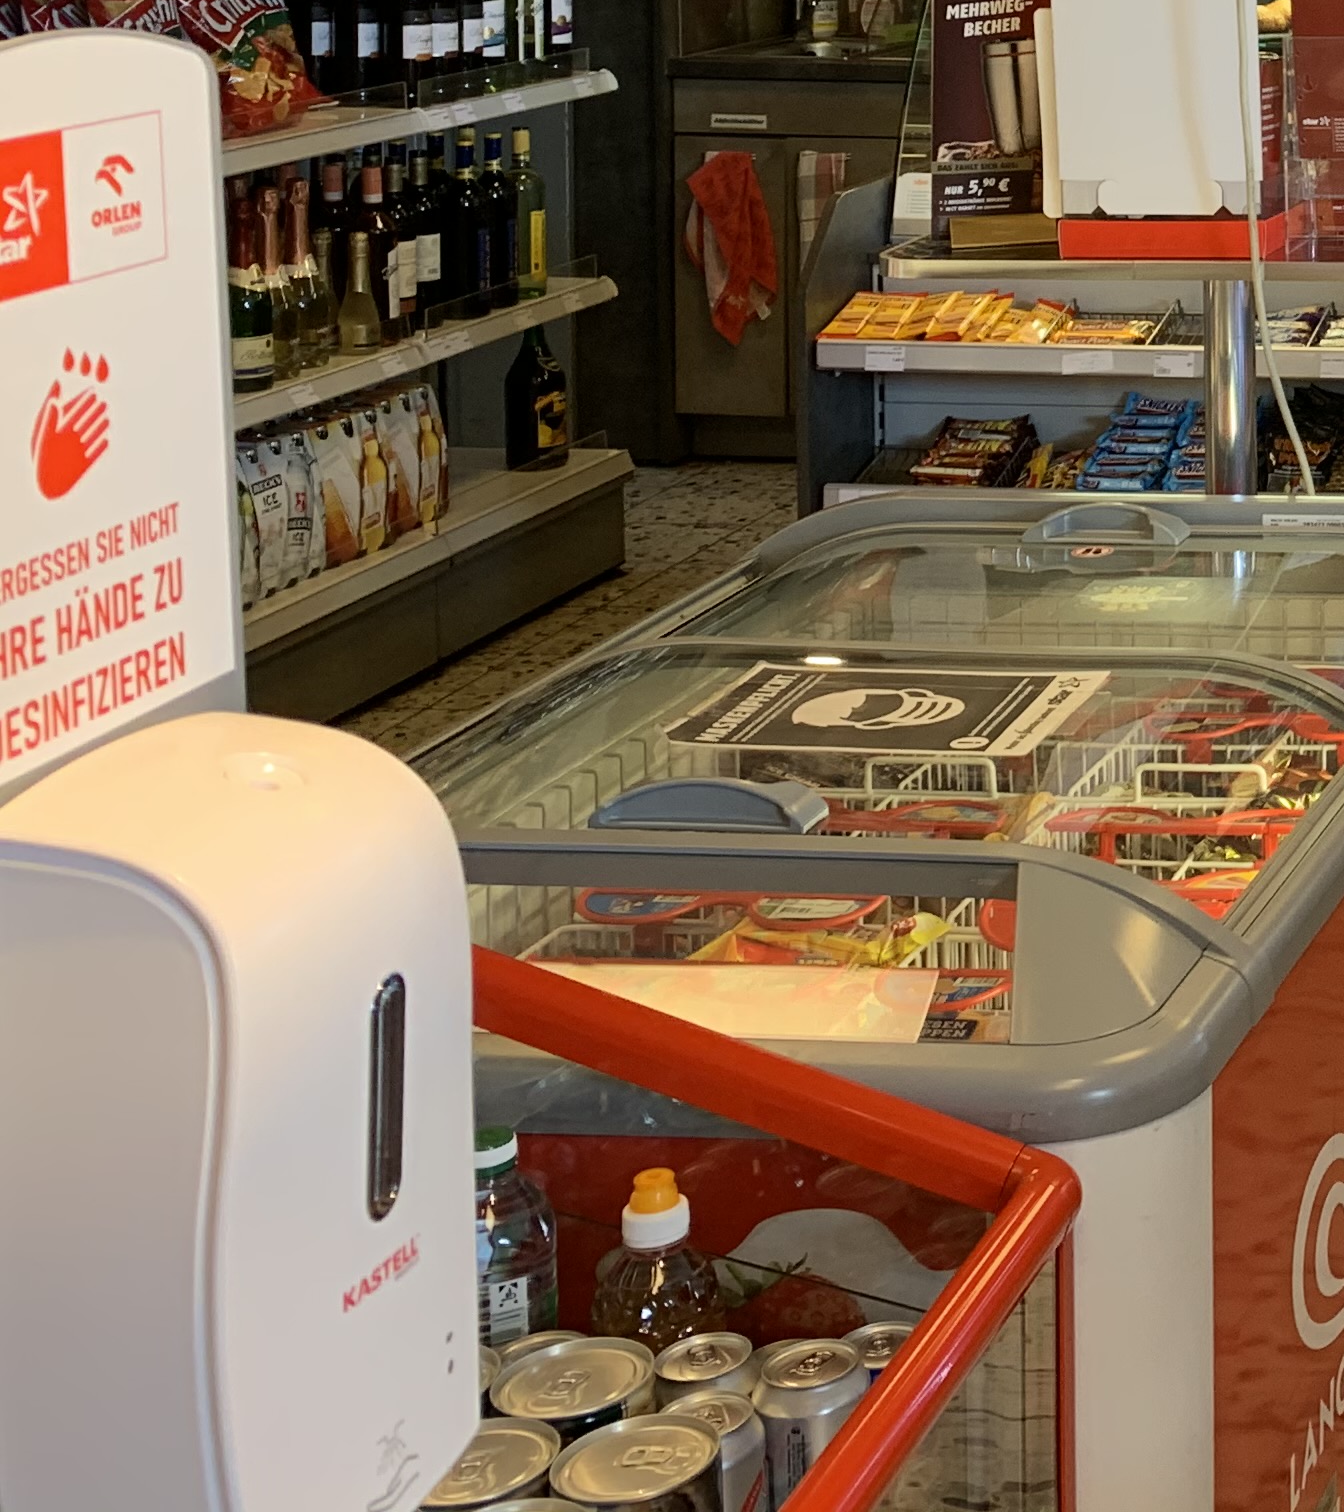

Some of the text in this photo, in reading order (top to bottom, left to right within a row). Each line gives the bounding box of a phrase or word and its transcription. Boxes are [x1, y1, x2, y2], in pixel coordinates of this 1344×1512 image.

[963, 17, 1022, 38] BECHER
[91, 200, 142, 229] ORLEN
[944, 177, 1010, 197] NUR 5,90 €
[96, 502, 180, 564] SIE NICHT
[56, 557, 184, 656] HÄNDE ZU
[694, 672, 802, 743] MASKENPFLICHT.
[341, 1238, 420, 1313] KASTELL
